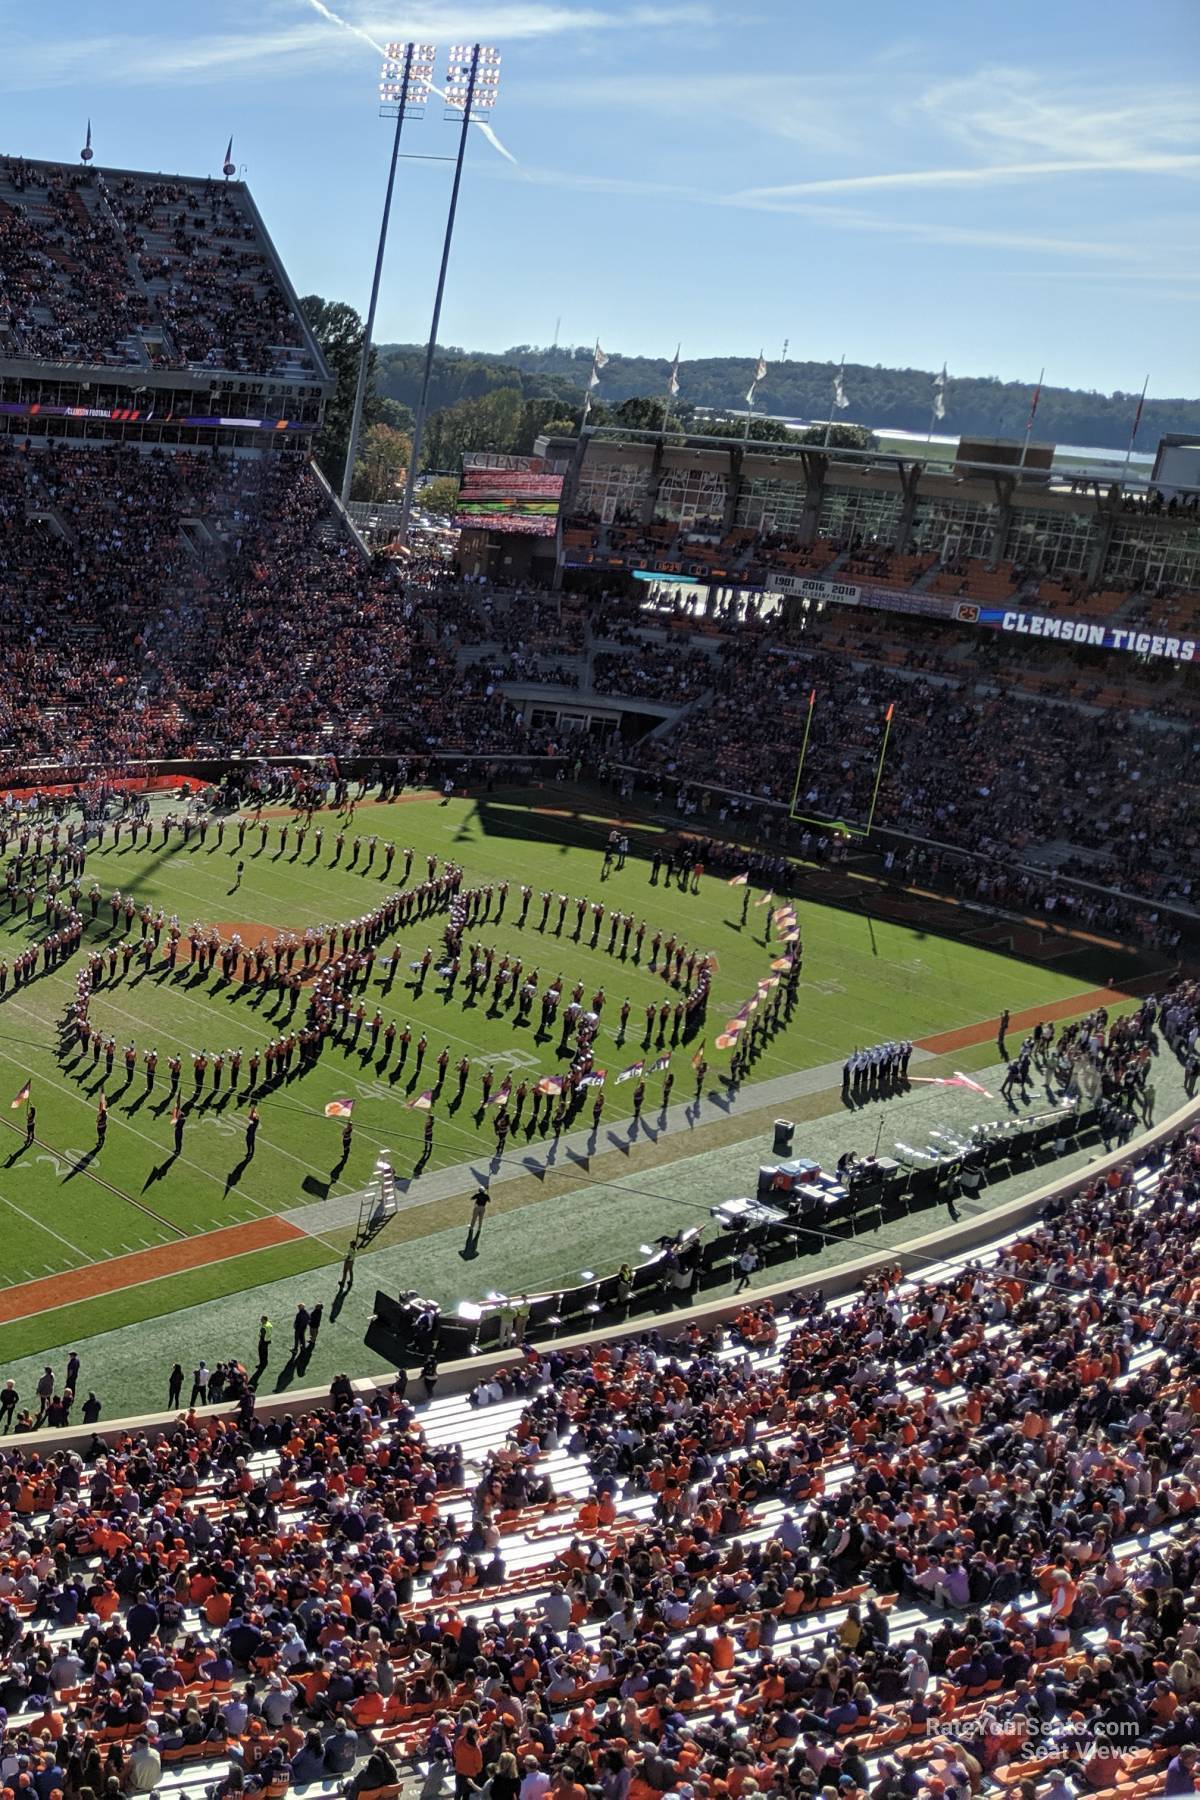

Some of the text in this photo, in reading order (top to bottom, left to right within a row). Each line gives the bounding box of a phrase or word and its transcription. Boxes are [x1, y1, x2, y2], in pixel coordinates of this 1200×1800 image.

[67, 407, 111, 418] CLEMSON FOOTBALL
[775, 576, 856, 596] 1981 2016 2018
[960, 607, 976, 619] 25
[1002, 612, 1196, 661] CLEMSON TIGERS
[36, 1149, 100, 1176] 20
